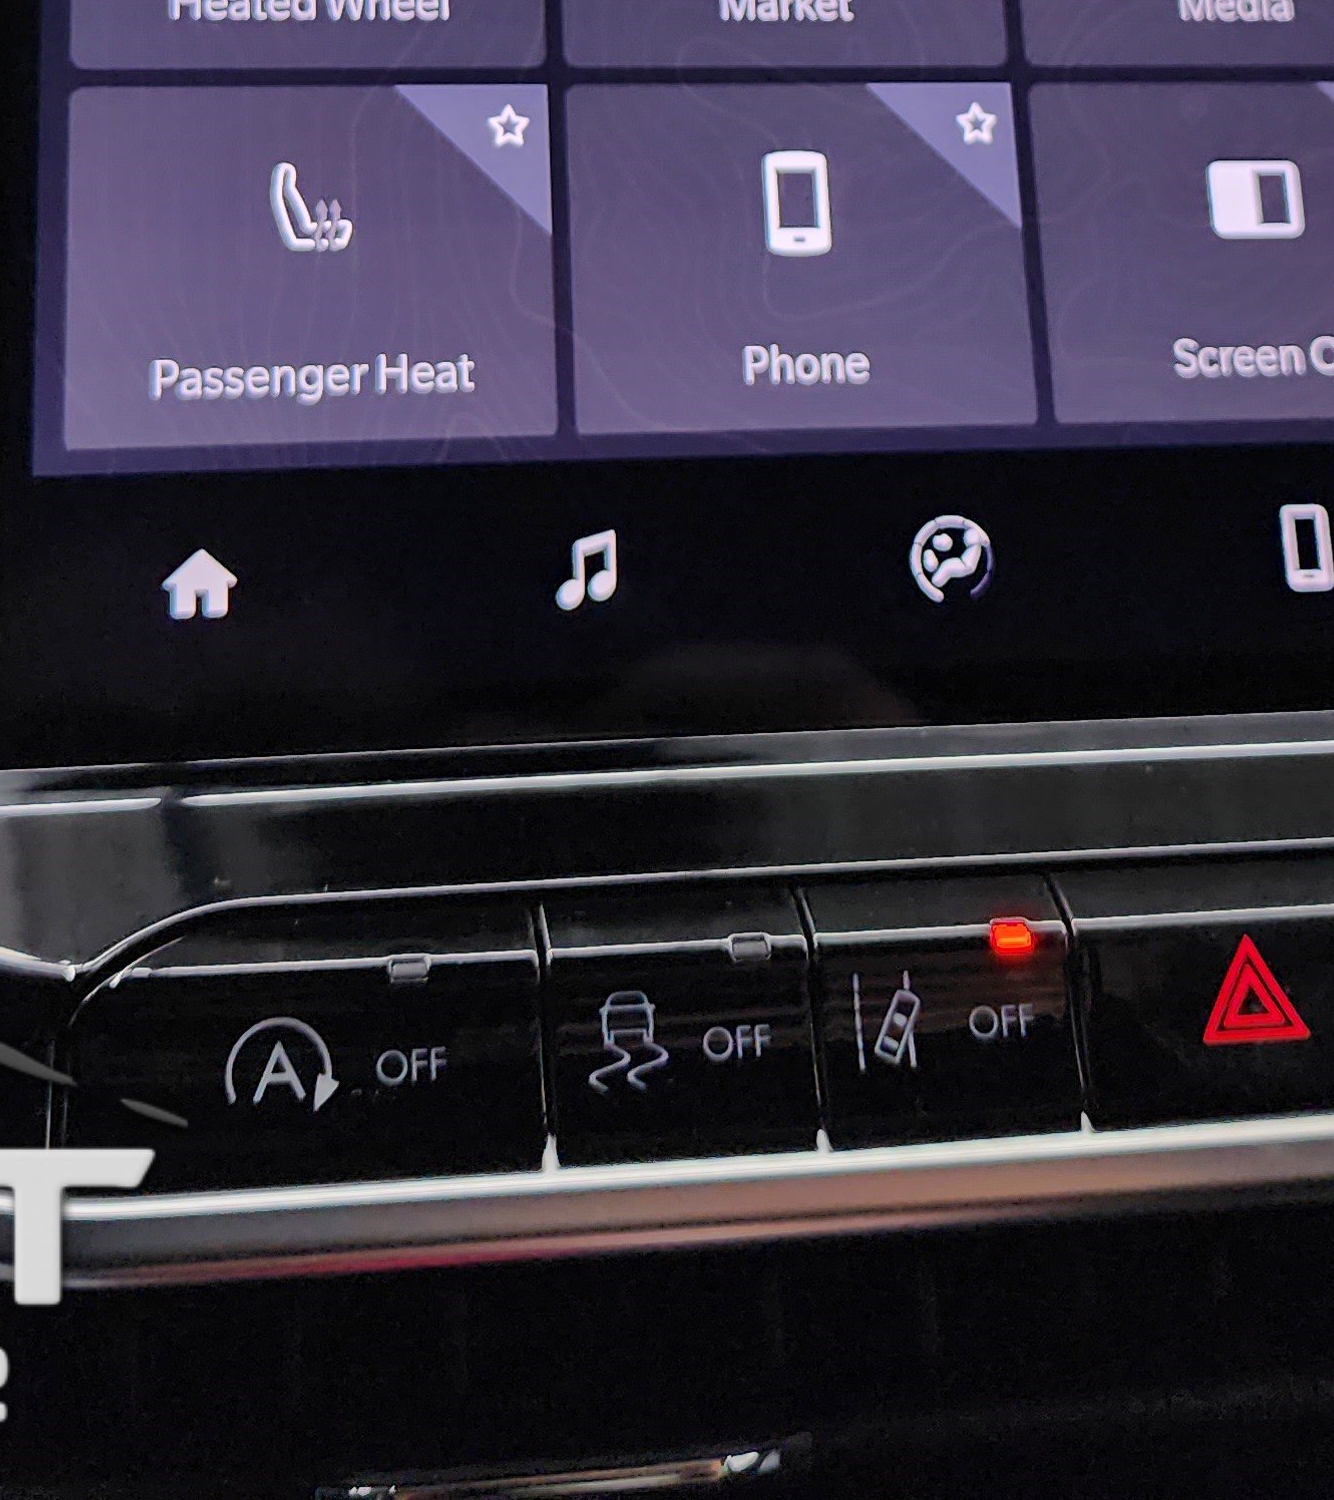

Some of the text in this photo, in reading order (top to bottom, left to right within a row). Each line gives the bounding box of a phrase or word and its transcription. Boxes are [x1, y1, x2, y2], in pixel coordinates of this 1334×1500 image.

[743, 343, 870, 385] Phone
[1173, 337, 1307, 379] Screen
[151, 353, 475, 404] Passenger Heat
[968, 1002, 1034, 1039] OFF
[702, 1024, 771, 1061] OFF
[375, 1046, 447, 1085] OFF
